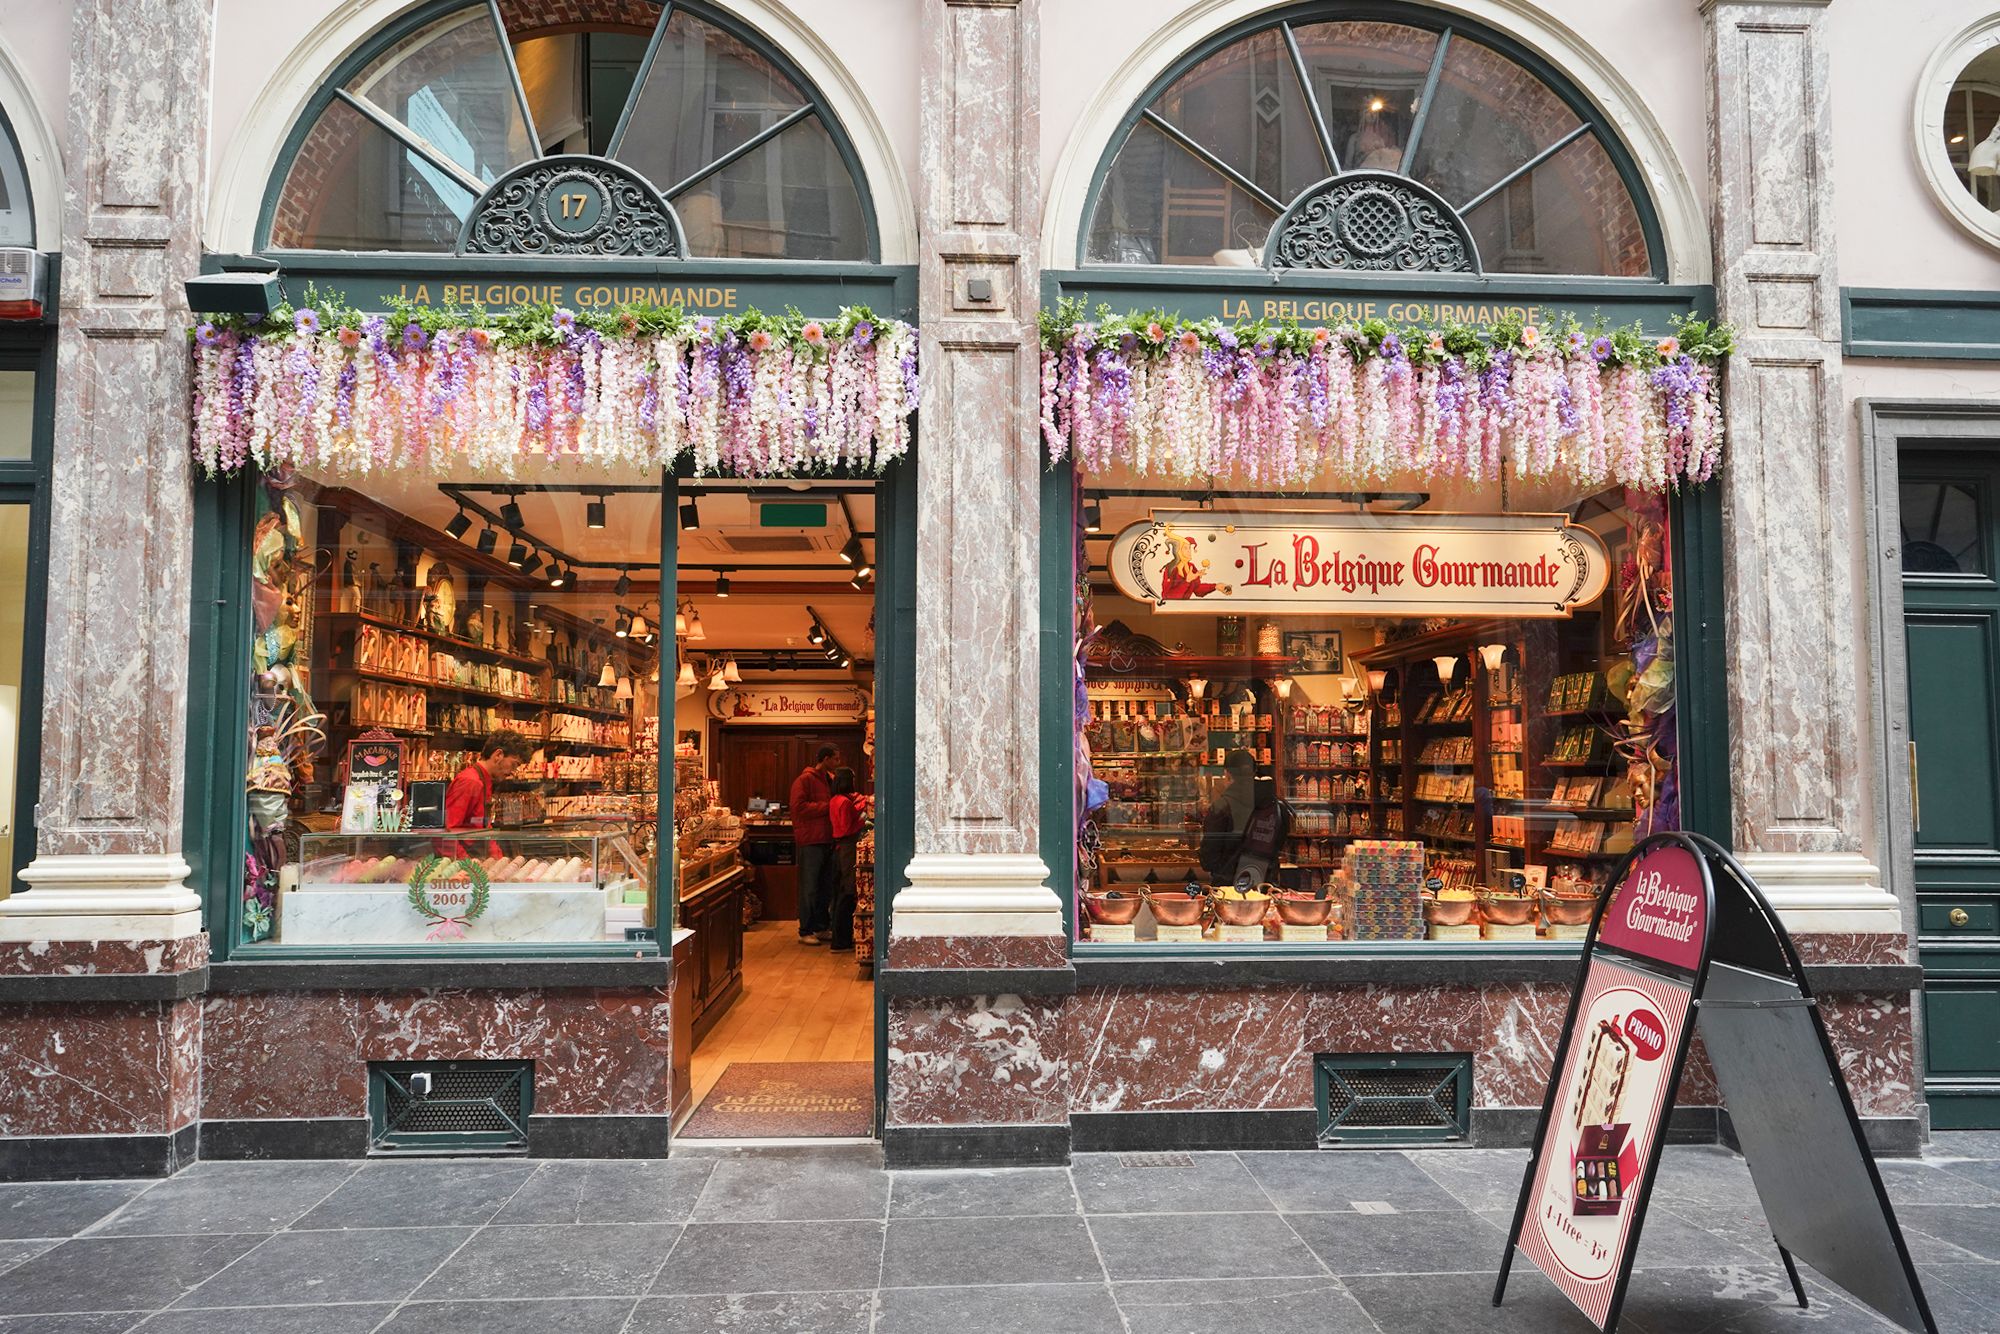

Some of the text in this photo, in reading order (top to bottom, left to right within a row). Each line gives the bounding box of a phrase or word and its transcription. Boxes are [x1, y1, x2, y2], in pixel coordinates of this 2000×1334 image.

[560, 193, 588, 219] 17
[401, 284, 737, 308] LA BELGIQUE GOURMANDE
[1223, 299, 1541, 325] LA BELGIQUE GOURMANDE
[1241, 534, 1560, 595] La Belgique Gourmande
[763, 695, 860, 713] La Belgique Gourmande
[354, 746, 398, 761] MACARONS
[430, 877, 470, 889] since
[433, 893, 466, 905] 2004
[1641, 870, 1698, 918] Belgique
[634, 931, 647, 942] 17
[1628, 1016, 1662, 1050] PROMO
[712, 1102, 862, 1113] Gourmande
[749, 1094, 858, 1106] Belgique
[1562, 1217, 1582, 1244] free
